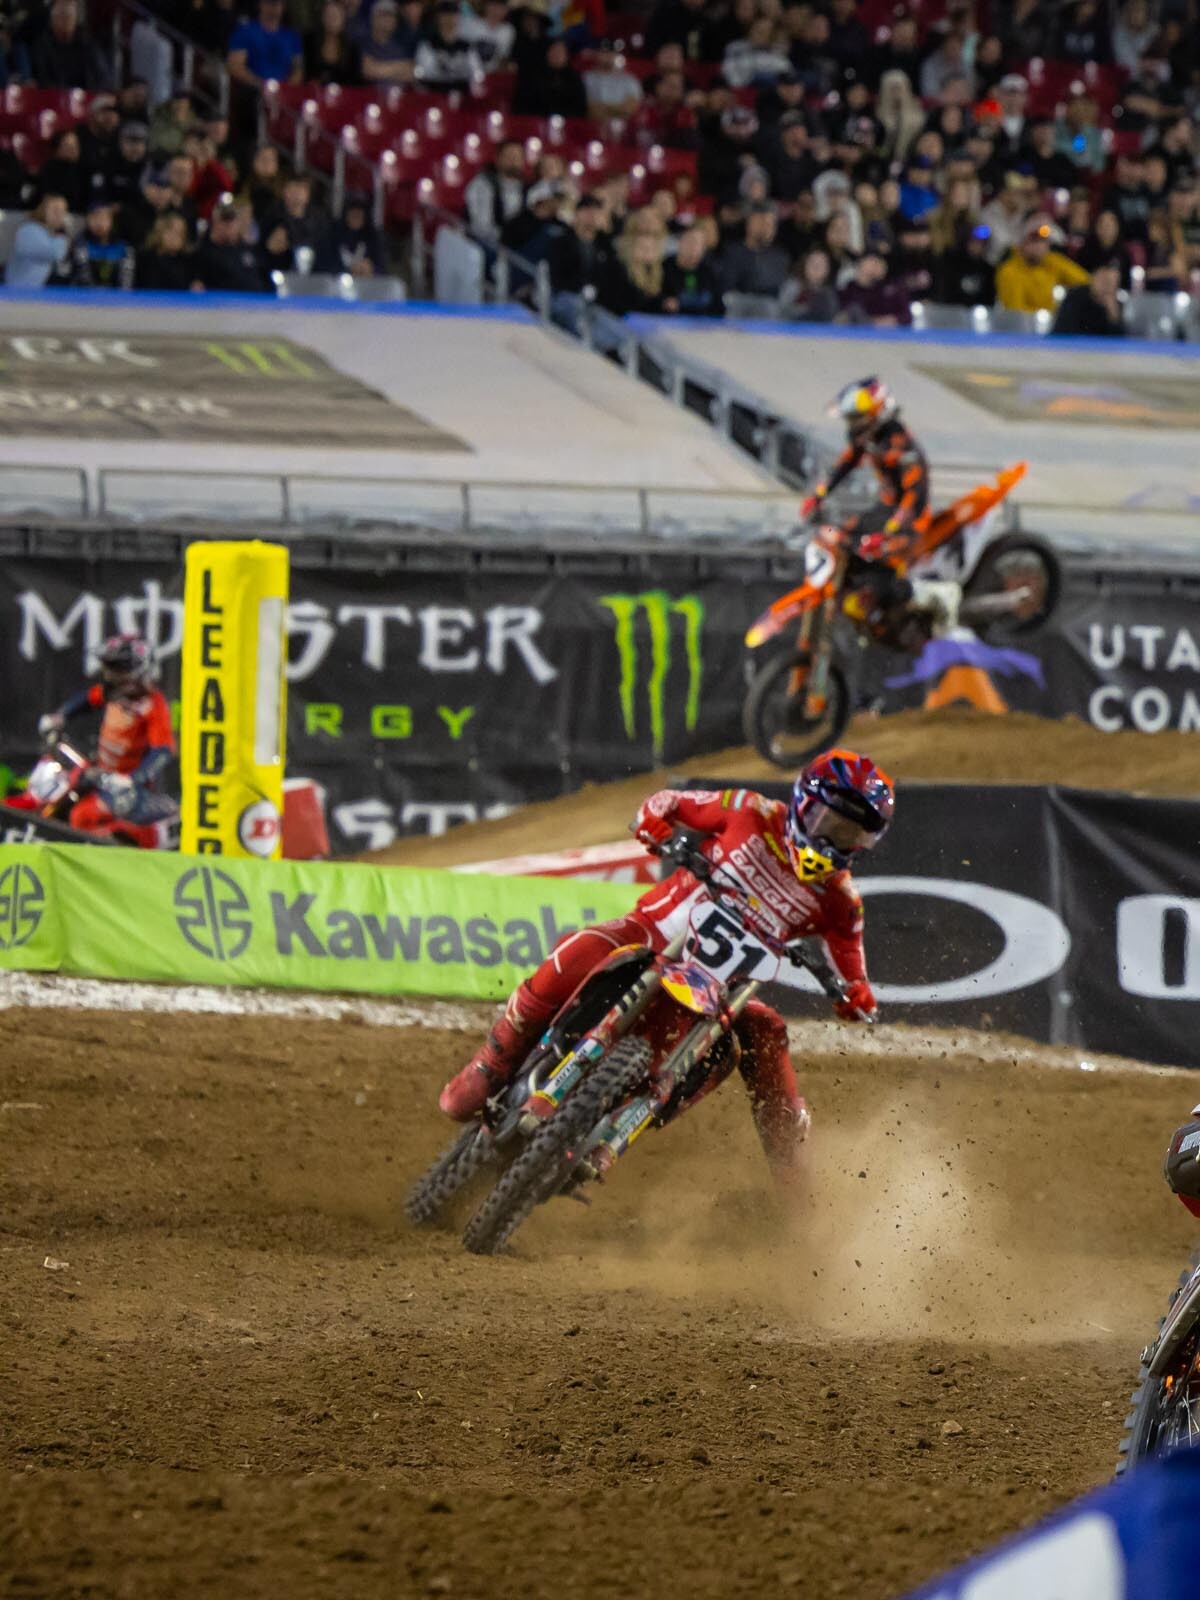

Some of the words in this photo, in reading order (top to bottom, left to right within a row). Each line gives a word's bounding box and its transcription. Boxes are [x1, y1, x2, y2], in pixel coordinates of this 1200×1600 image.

[18, 580, 557, 683] MOSTER
[729, 849, 808, 927] GASGAS
[686, 909, 767, 984] 51
